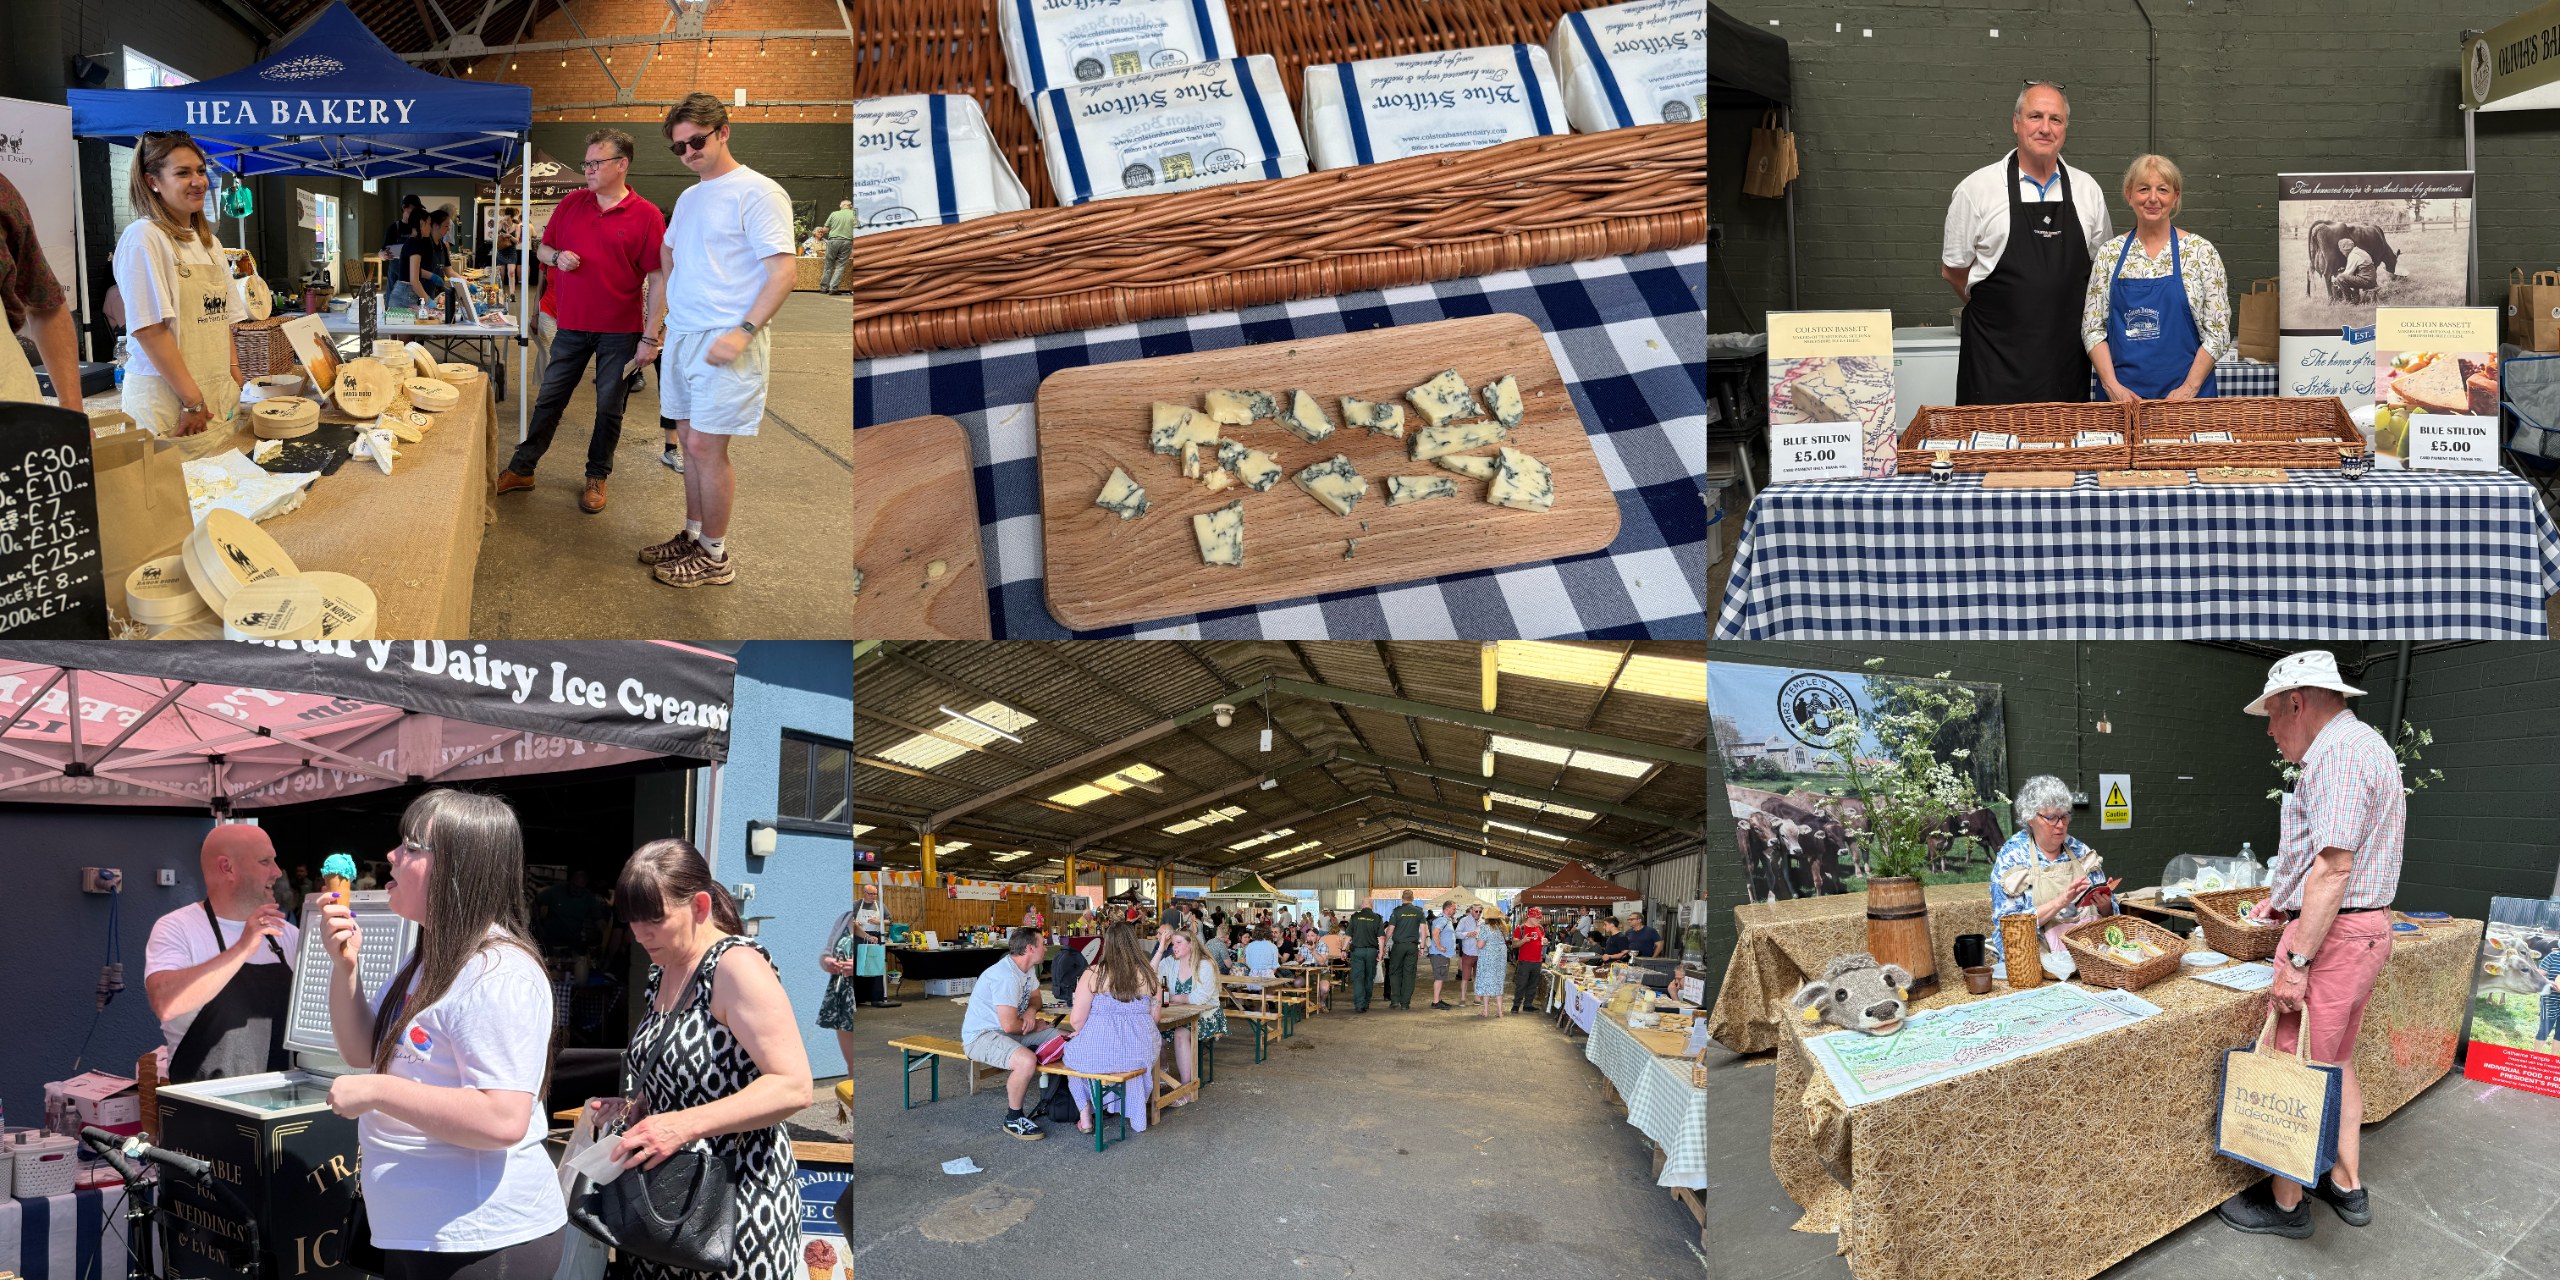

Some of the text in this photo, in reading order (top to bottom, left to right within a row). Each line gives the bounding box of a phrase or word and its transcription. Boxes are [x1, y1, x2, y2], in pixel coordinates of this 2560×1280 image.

[2498, 34, 2538, 77] OLIVIA'S
[1370, 74, 1404, 90] methods
[1417, 70, 1440, 84] recipe
[1440, 69, 1480, 82] honoured
[1480, 68, 1508, 82] Time
[1174, 79, 1233, 101] Blue
[1462, 84, 1520, 105] Blue
[186, 98, 417, 126] HEA BAKERY
[886, 109, 918, 125] Time
[858, 128, 922, 151] Blue
[1186, 134, 1202, 142] Trade
[1402, 127, 1507, 142] www.colstonbassettdairy.com
[1440, 140, 1471, 149] Certification
[8, 154, 34, 165] Dairy
[1216, 154, 1231, 162] GB
[858, 187, 894, 197] Trade Mark
[2290, 180, 2311, 195] Time
[2312, 183, 2341, 194] honoured
[2342, 185, 2361, 198] recipe
[2372, 182, 2398, 193] methods
[885, 213, 902, 221] GB
[2354, 331, 2371, 340] EST.
[2301, 348, 2369, 375] The home of
[2292, 375, 2351, 396] Stilton &
[2419, 426, 2487, 436] BLUE STILTON
[1783, 434, 1851, 446] BLUE STILTON
[2431, 440, 2471, 452] £5.00
[1794, 448, 1836, 462] £5.00
[329, 603, 357, 622] BARON
[411, 640, 730, 732] Dairy Ice Cream
[1785, 678, 1828, 698] TEMPLE'S
[1782, 702, 1794, 723] MRS
[1406, 861, 1418, 875] E
[2483, 1062, 2521, 1075] INDIVIDUAL
[2522, 1070, 2543, 1079] FOOD
[2500, 1071, 2546, 1086] PRESIDENT'S
[2234, 1086, 2308, 1120] norfolk
[2233, 1101, 2308, 1134] hideaways
[174, 1199, 245, 1243] WEDDINGS
[192, 1237, 226, 1265] EVEN
